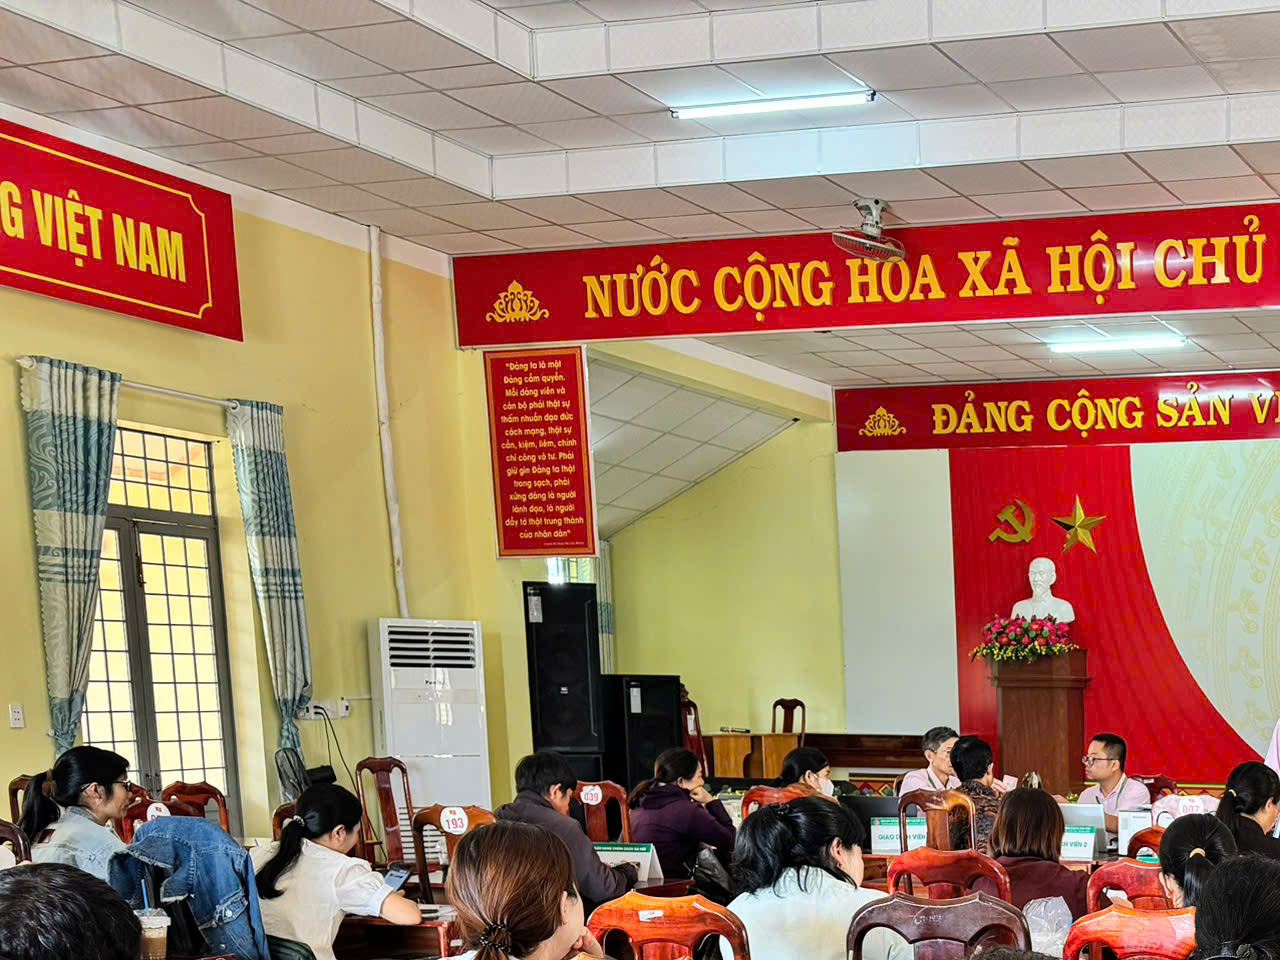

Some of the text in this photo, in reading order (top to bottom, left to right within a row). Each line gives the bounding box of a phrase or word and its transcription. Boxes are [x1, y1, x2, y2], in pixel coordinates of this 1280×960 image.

[32, 188, 103, 267] VIỆT
[112, 212, 186, 283] NAM
[583, 255, 700, 320] NƯỚC
[714, 250, 834, 322] CỘNG
[958, 237, 1033, 297] XÃ
[1047, 229, 1137, 304] HỘI
[1154, 215, 1266, 288] CHỦ
[932, 390, 1033, 435] ĐẢNG
[1046, 389, 1144, 438] CỘNG
[1156, 382, 1230, 428] SẢN
[446, 818, 465, 830] 193
